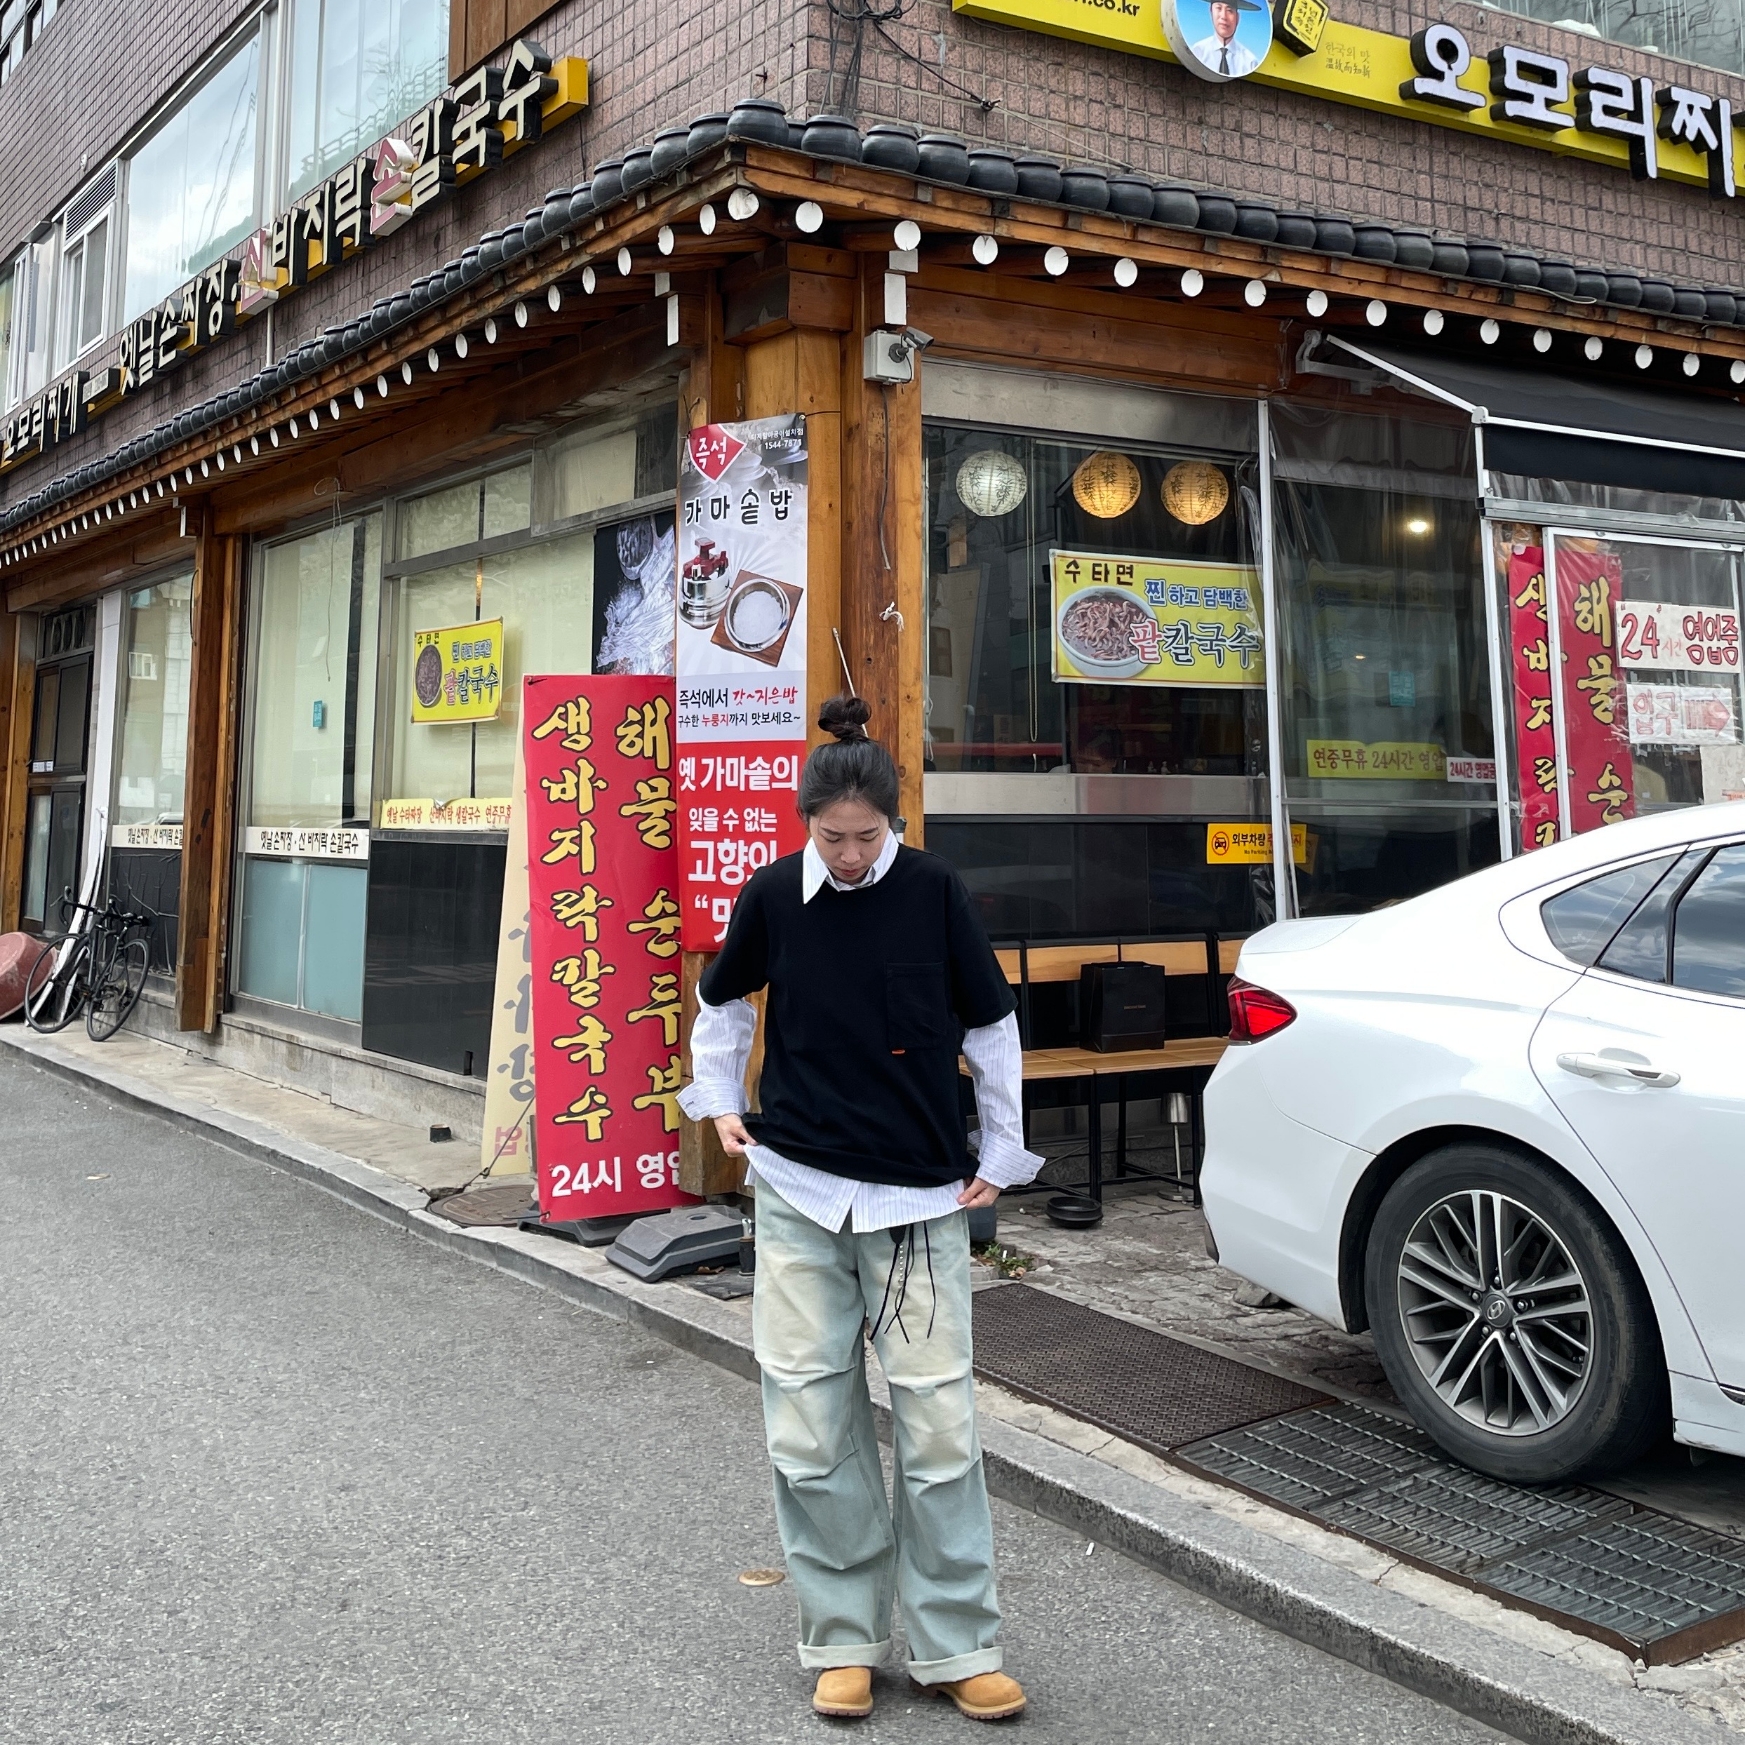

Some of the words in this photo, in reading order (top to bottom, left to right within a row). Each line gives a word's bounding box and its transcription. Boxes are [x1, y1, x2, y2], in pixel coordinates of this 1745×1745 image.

[1412, 23, 1745, 198] 오모리찌
[695, 437, 727, 470] 즉석
[1203, 586, 1249, 611] 담백한
[1130, 619, 1262, 670] 팥칼국수
[1683, 611, 1739, 666] 영업중
[679, 688, 728, 709] 즉석에서
[1632, 687, 1679, 736] 입구
[702, 713, 748, 727] 누룽지까지
[615, 696, 678, 850] 해물
[679, 757, 696, 791] 옛
[700, 755, 798, 791] 가마솥의
[1313, 748, 1368, 772] 연중무휴
[1372, 750, 1415, 772] 24시간
[689, 808, 718, 832] 잊을
[723, 808, 739, 832] 수
[743, 808, 777, 832] 없는
[1232, 833, 1265, 847] 외부차량
[551, 1156, 622, 1198] 24시
